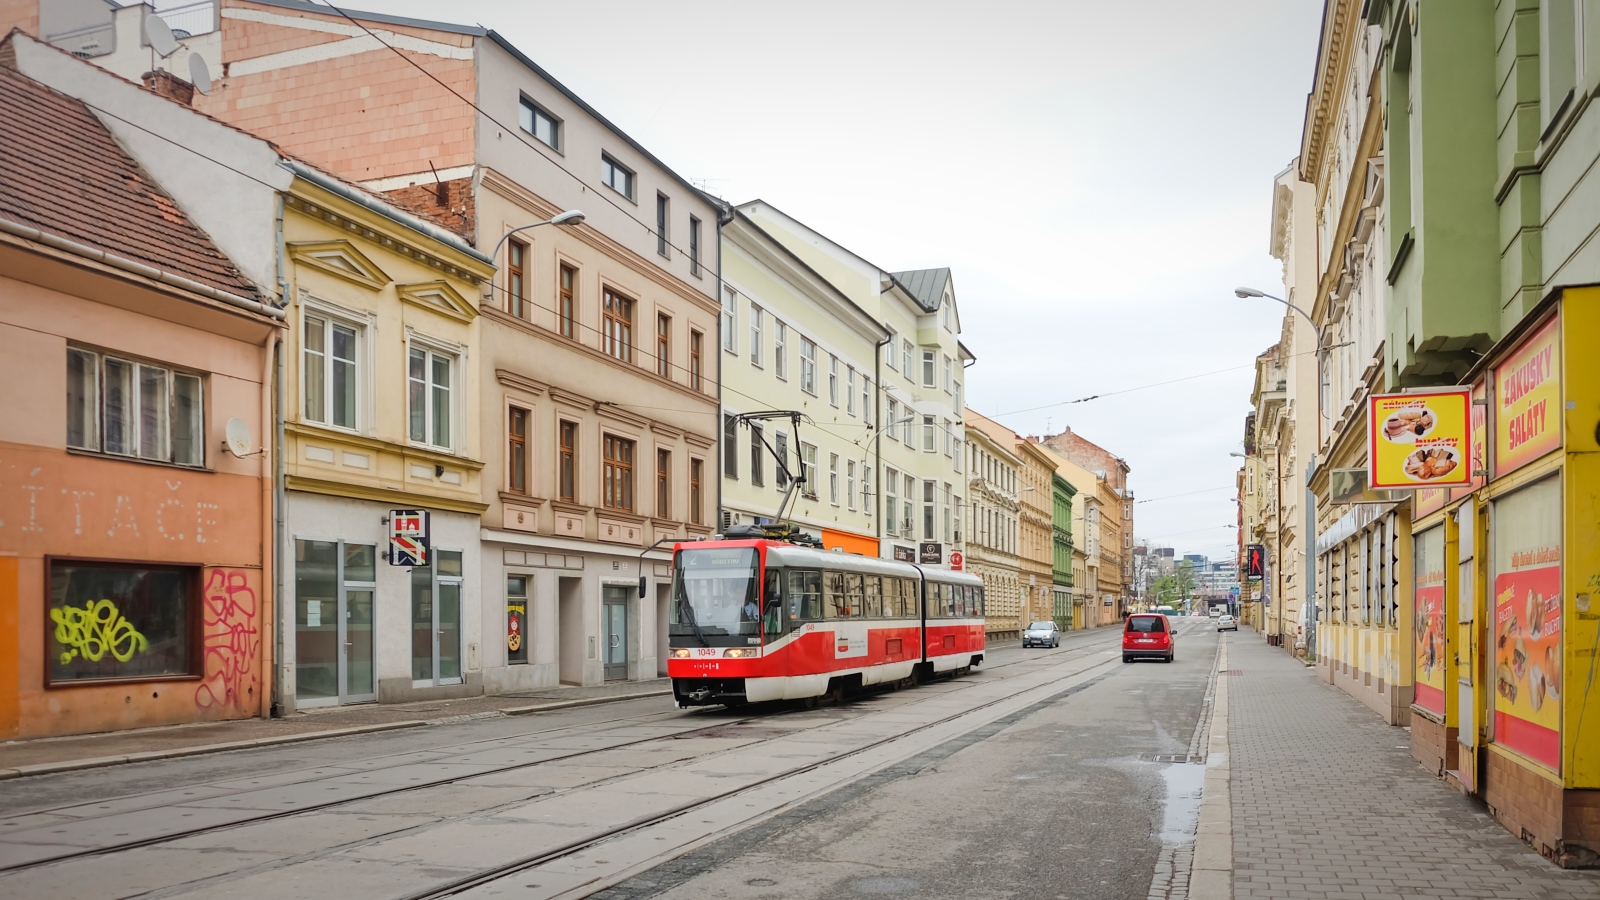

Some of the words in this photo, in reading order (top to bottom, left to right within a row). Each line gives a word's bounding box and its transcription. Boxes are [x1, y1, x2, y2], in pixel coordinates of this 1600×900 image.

[1504, 343, 1552, 408] ZÁKUSKY
[1509, 398, 1546, 450] SALÁTY
[0, 466, 220, 543] ÍTAČE
[689, 553, 697, 566] 2
[806, 623, 815, 631] 1049
[697, 648, 716, 656] 1049
